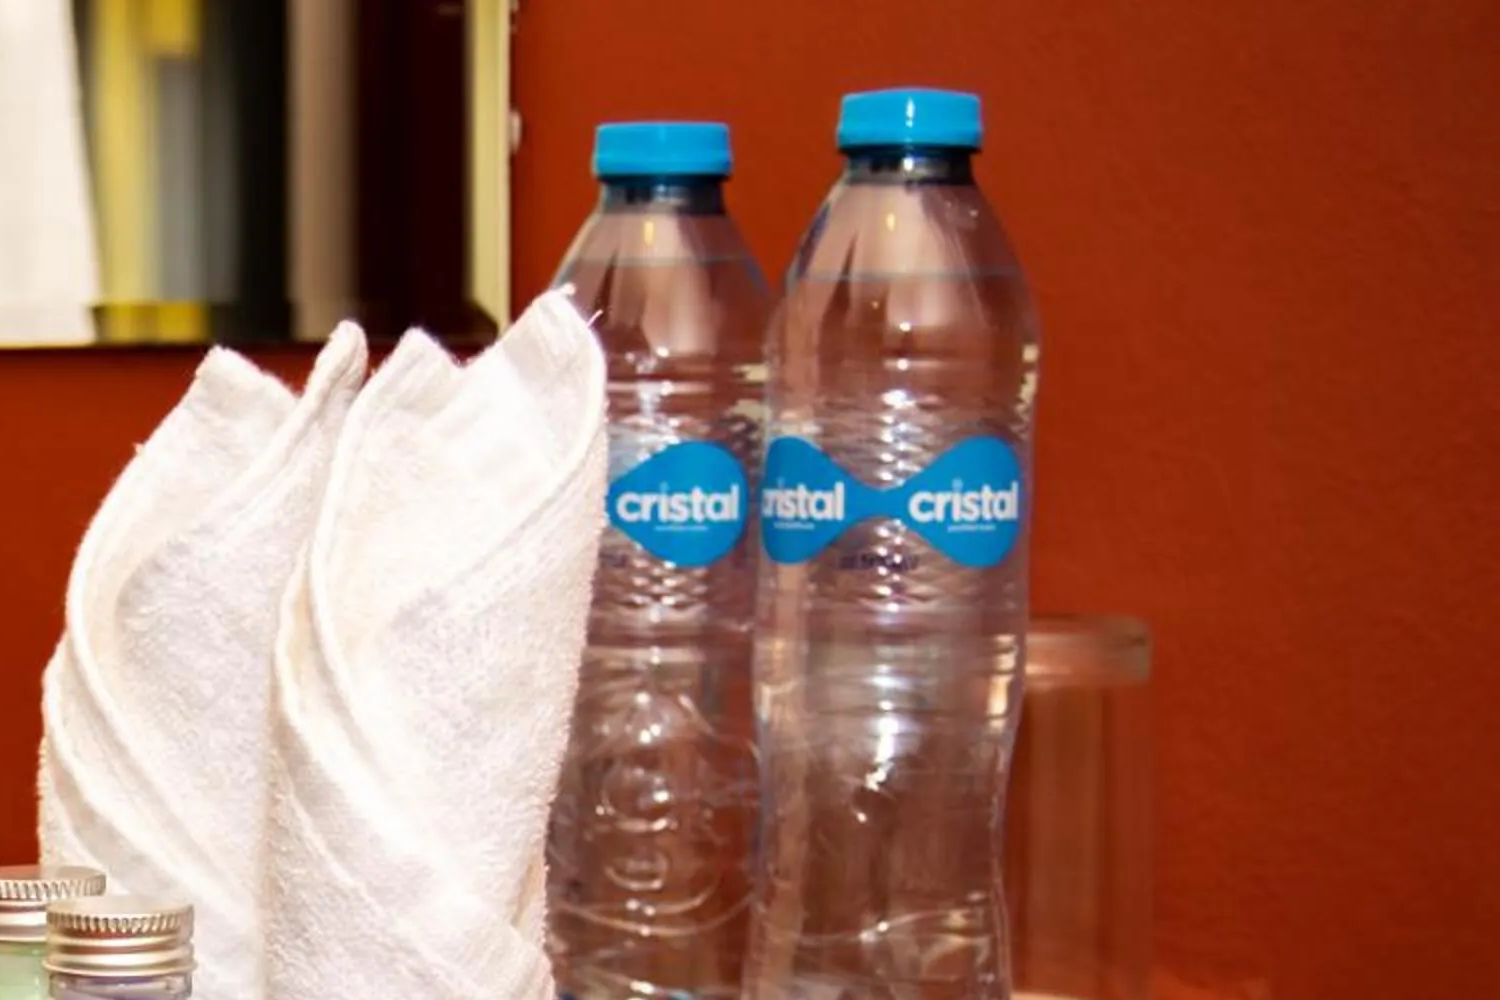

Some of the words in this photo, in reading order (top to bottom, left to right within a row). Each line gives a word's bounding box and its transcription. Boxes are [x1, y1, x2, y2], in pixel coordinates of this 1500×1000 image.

[617, 481, 739, 521] cristal
[762, 478, 844, 520] ristal
[909, 478, 1019, 522] cristal
